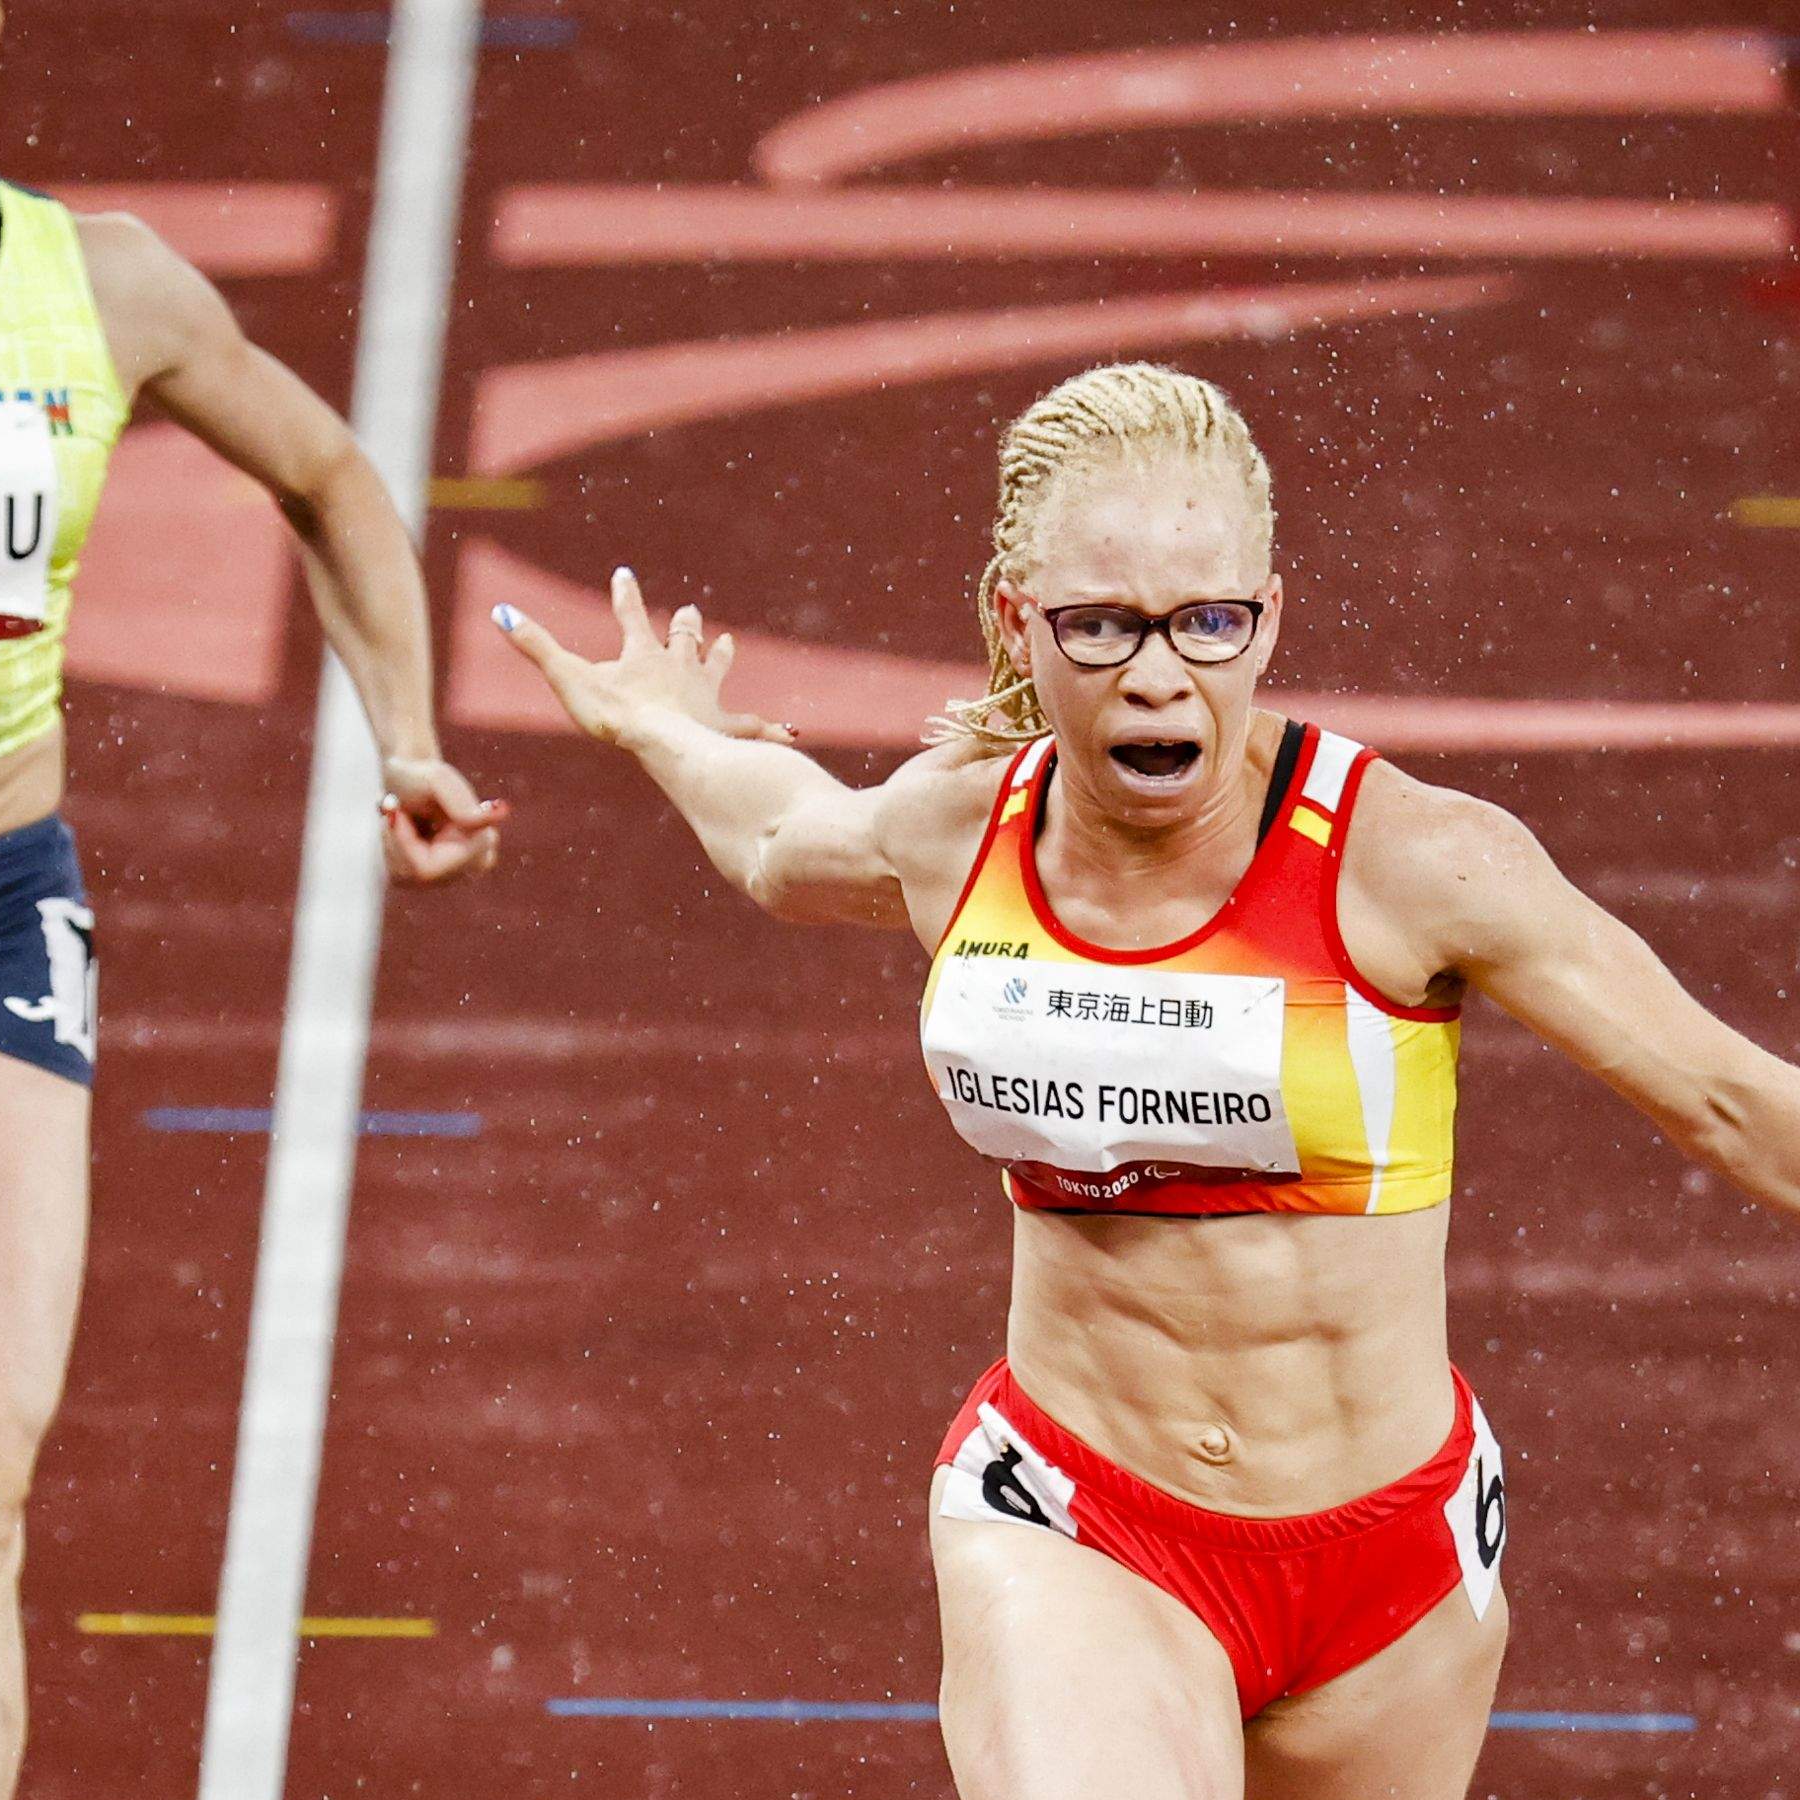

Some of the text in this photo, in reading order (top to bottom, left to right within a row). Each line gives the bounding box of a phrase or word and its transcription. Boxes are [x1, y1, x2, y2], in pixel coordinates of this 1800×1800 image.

[954, 939, 1030, 960] AMURA
[1046, 989, 1214, 1030] 東京海上日動
[947, 1066, 1272, 1125] IGLESIAS FORNEIRO
[1056, 1171, 1139, 1199] TOKYO 2020
[1476, 1454, 1504, 1569] 6
